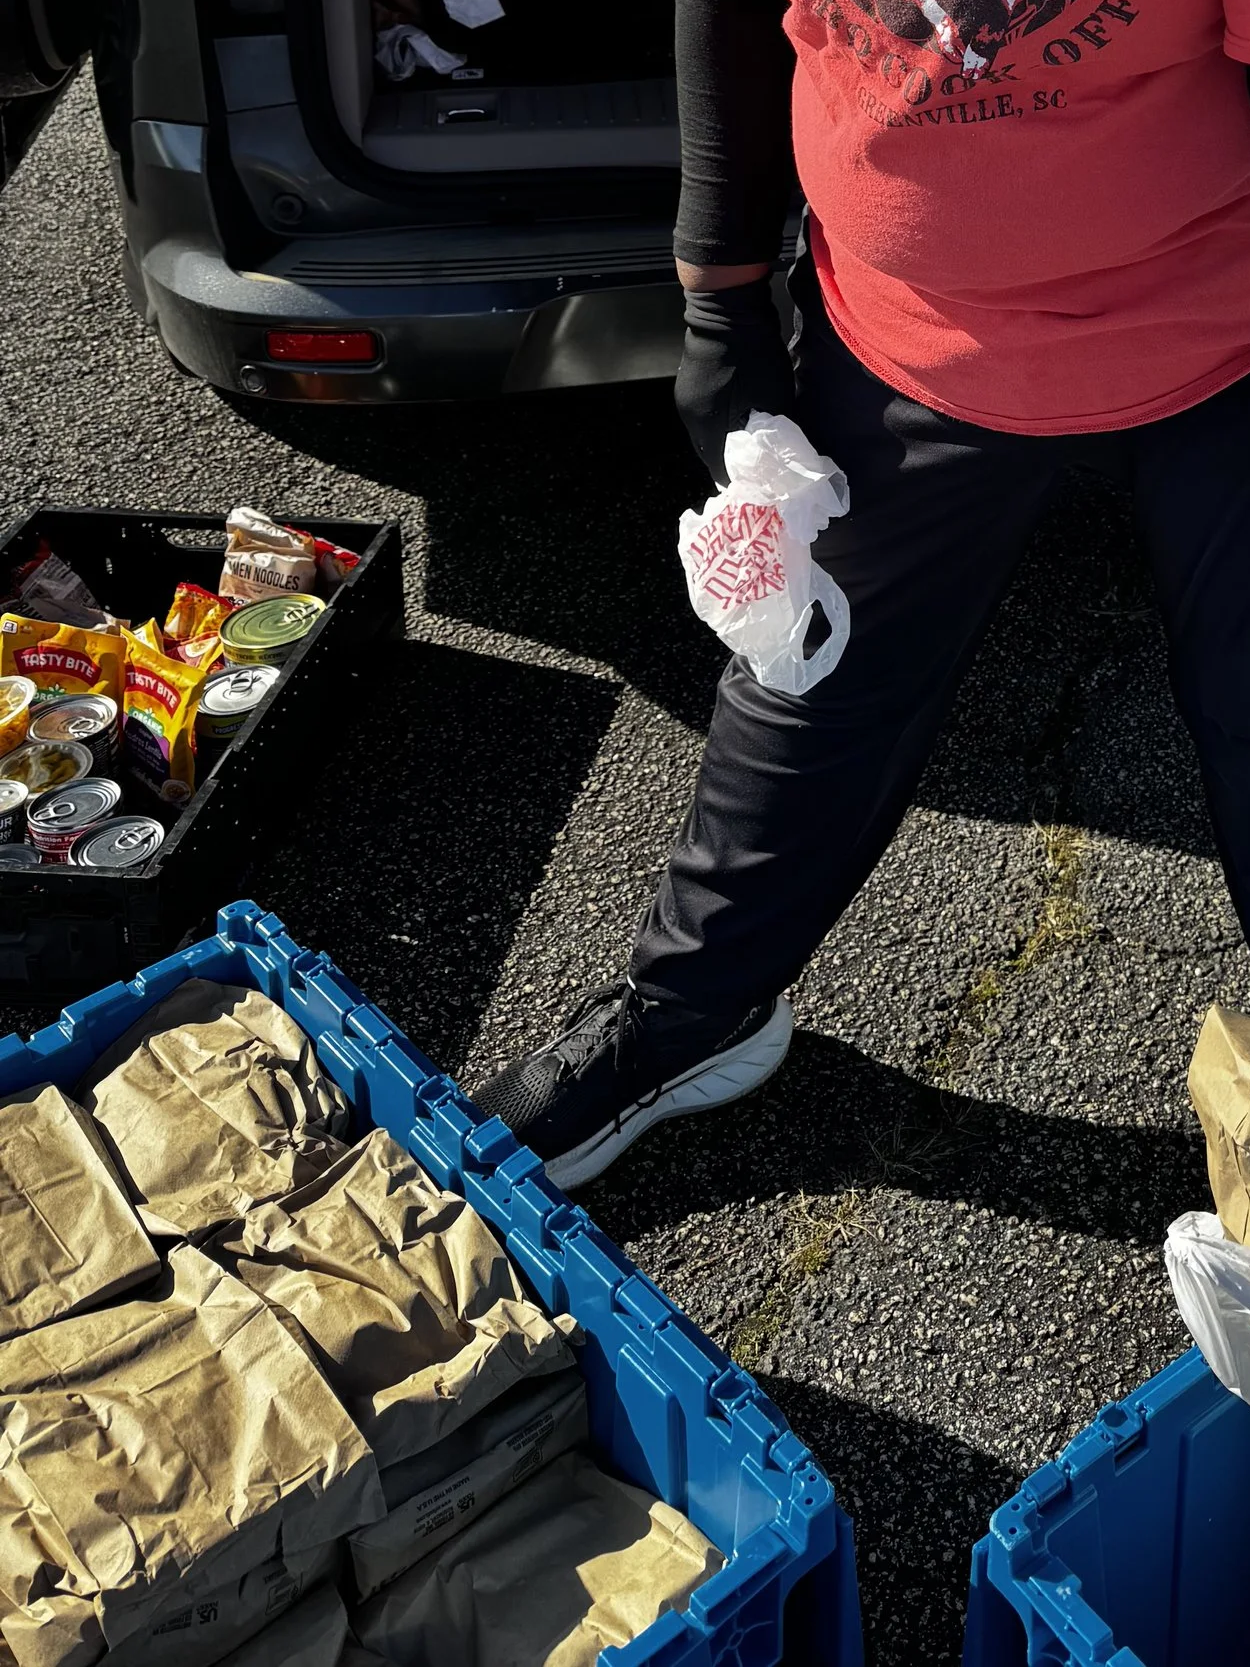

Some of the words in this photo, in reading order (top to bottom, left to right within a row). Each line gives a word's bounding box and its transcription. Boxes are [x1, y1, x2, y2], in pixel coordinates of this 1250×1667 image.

[1033, 89, 1068, 111] SC
[253, 566, 300, 591] NOODLES
[21, 652, 64, 668] TASTY
[66, 656, 95, 678] BITE
[156, 684, 178, 709] BITE
